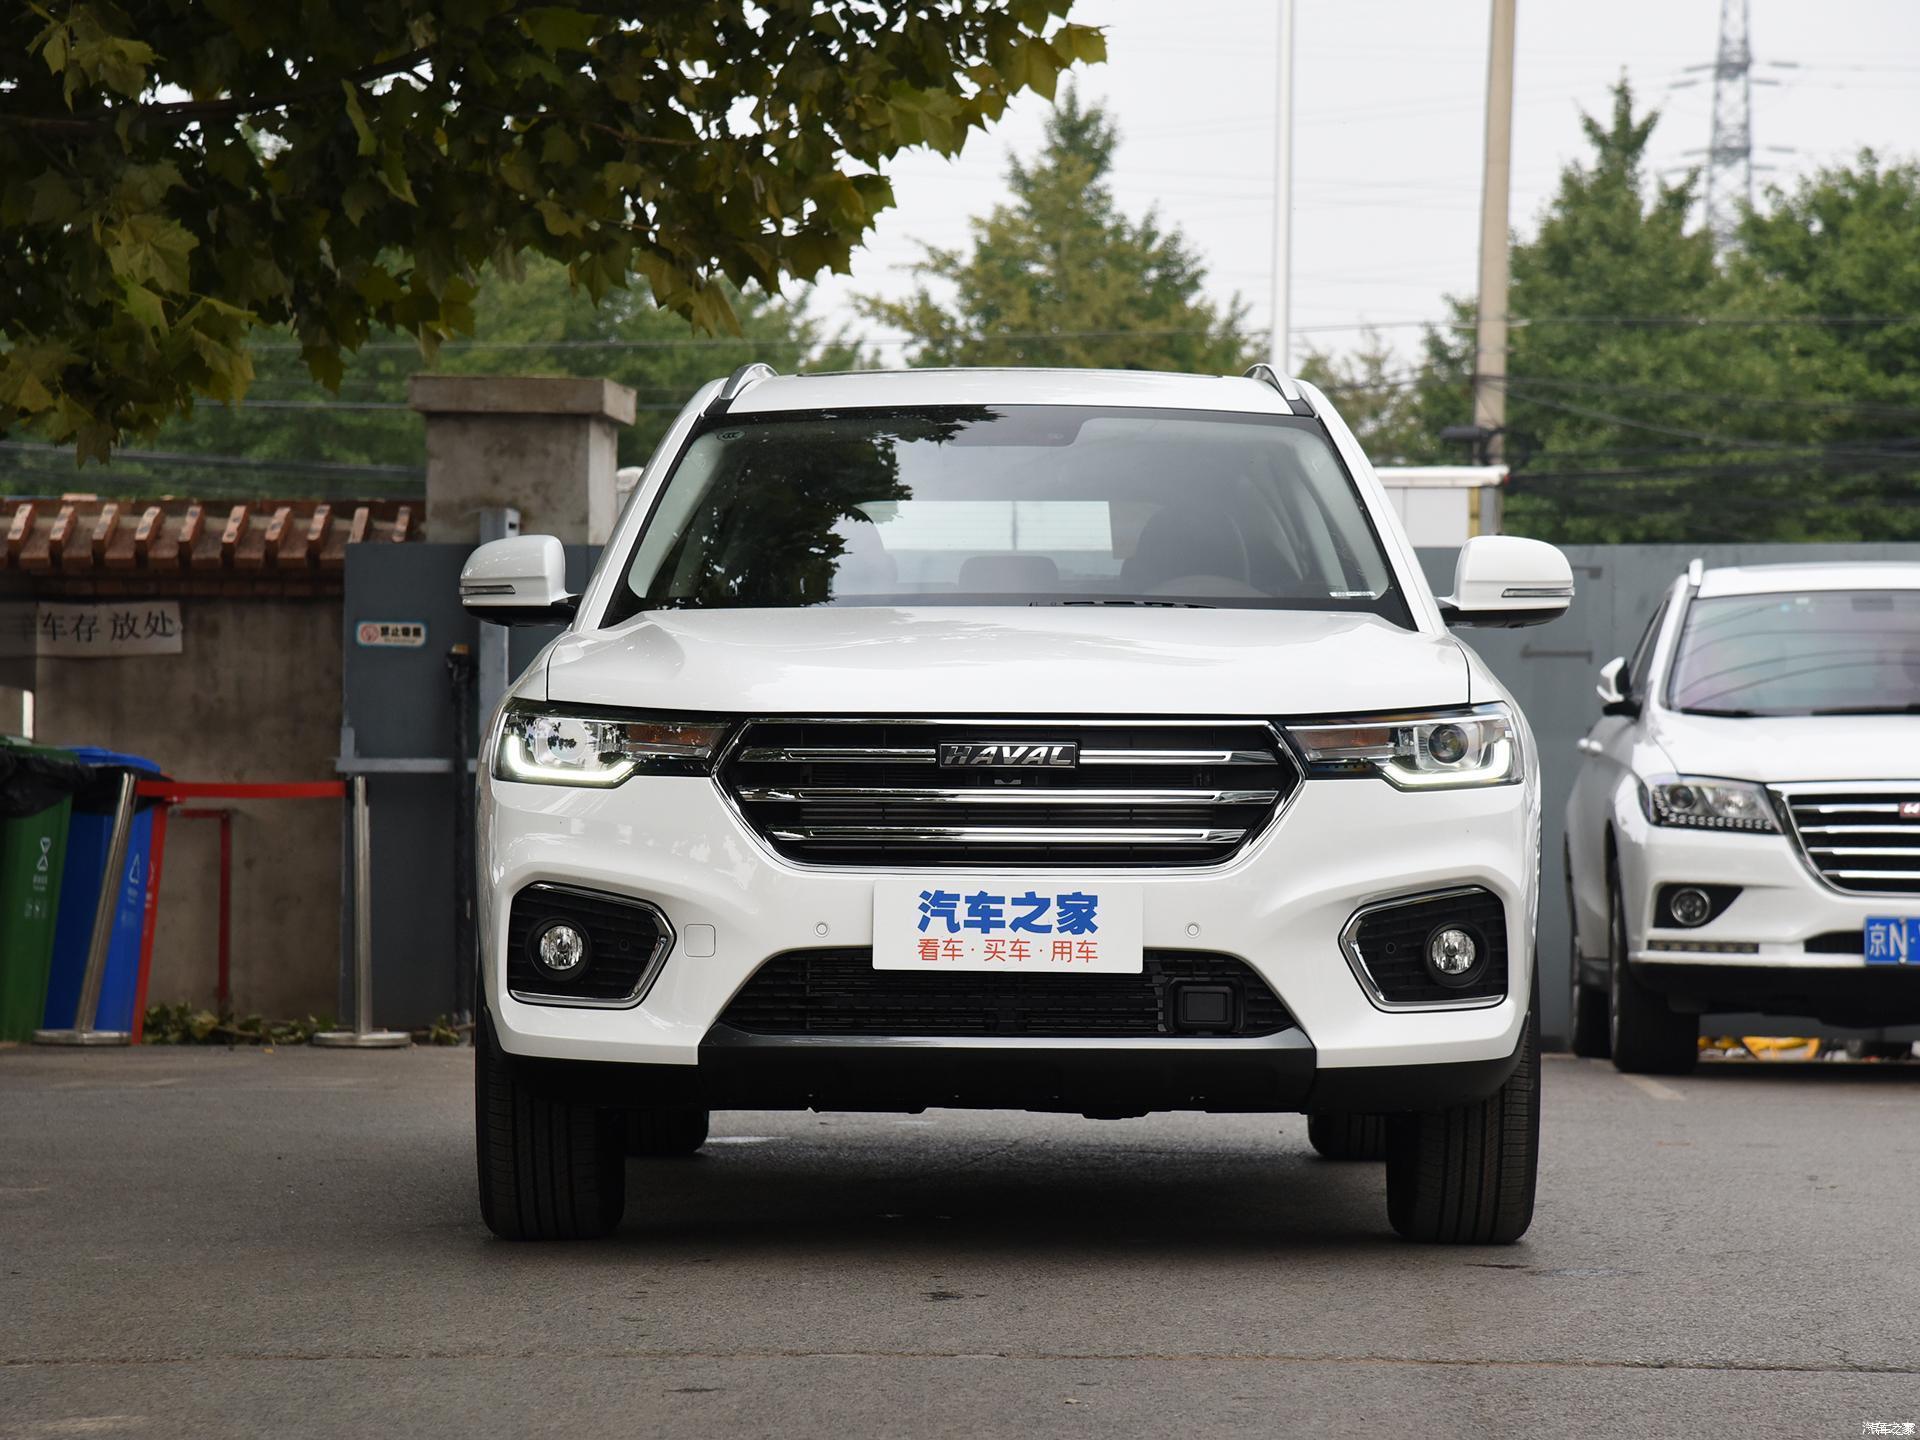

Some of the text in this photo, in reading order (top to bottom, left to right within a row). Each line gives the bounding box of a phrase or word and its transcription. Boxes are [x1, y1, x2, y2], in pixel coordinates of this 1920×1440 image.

[943, 746, 1072, 765] HAVAL
[917, 889, 1100, 936] 汽车之家
